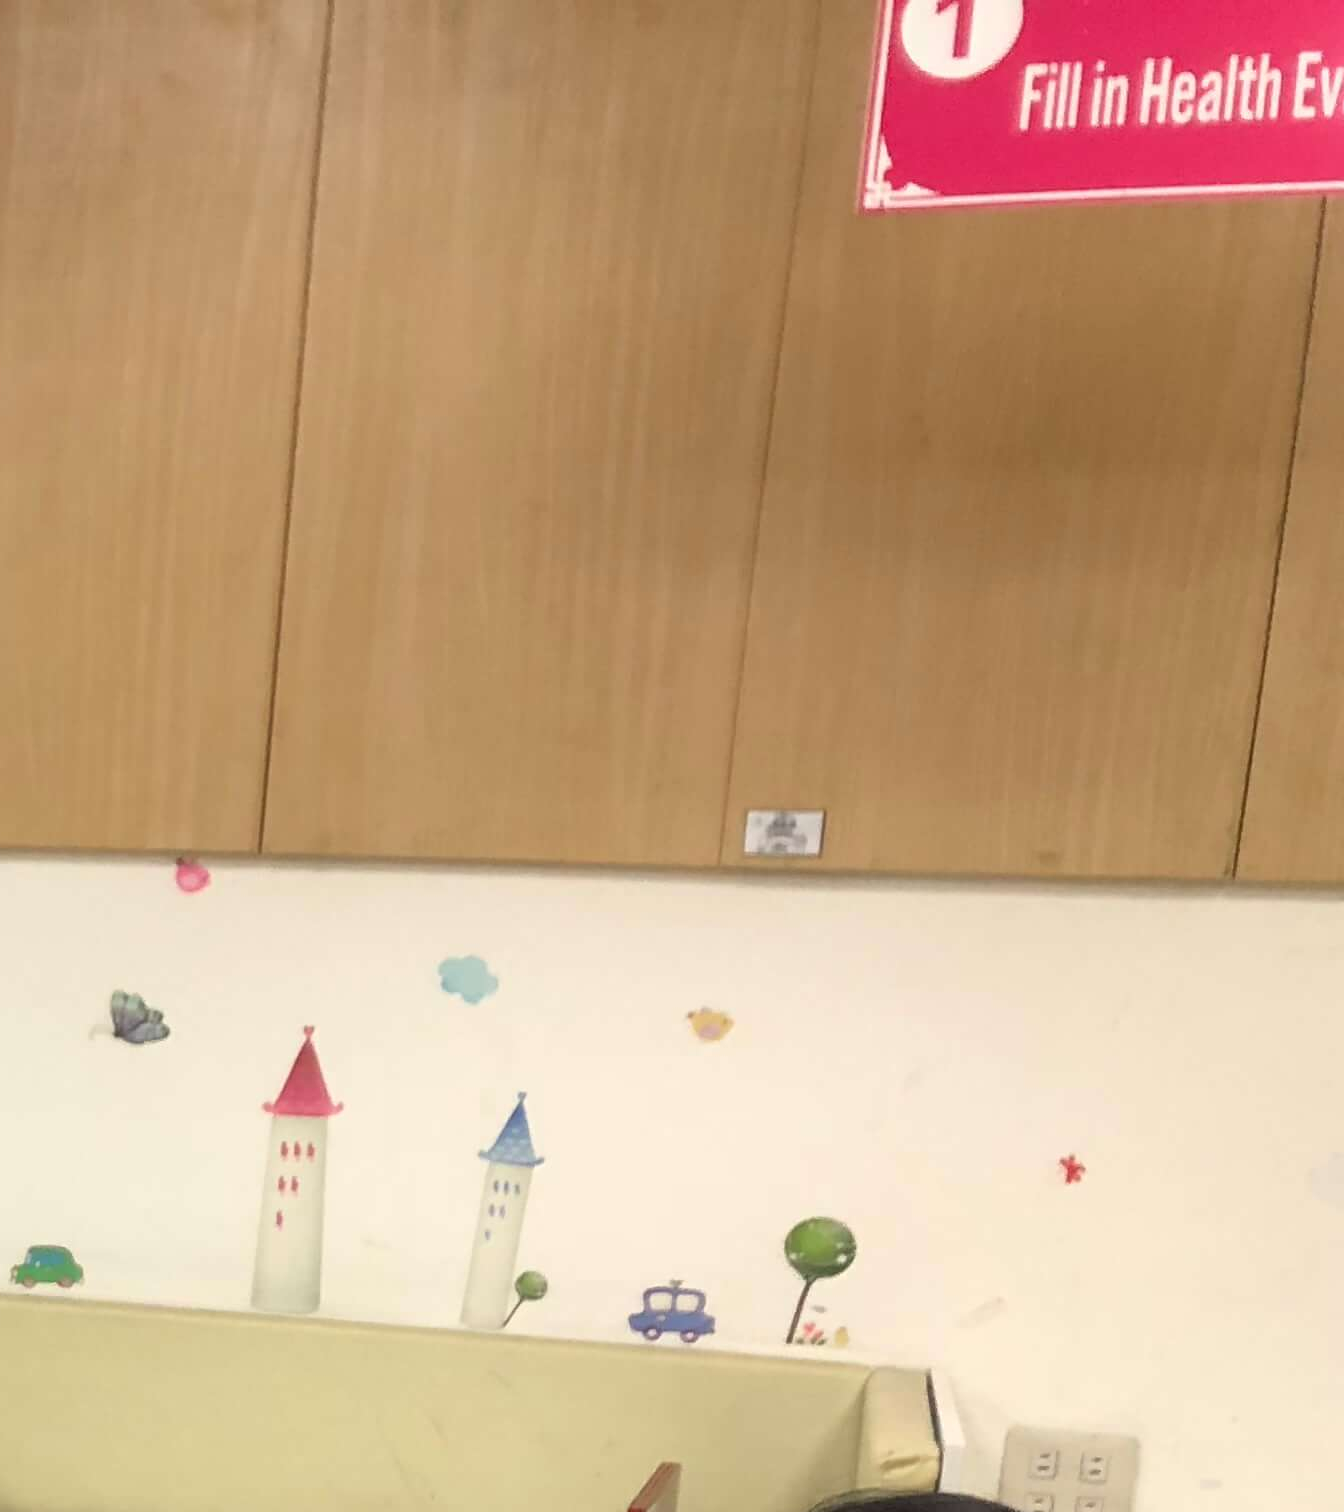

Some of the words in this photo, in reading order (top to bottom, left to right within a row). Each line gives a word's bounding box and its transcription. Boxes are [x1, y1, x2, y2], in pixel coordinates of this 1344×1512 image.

[934, 0, 974, 60] 1
[1018, 61, 1084, 131] Fill
[1090, 60, 1128, 127] in
[1138, 53, 1283, 125] Health
[1293, 51, 1344, 118] Ev
